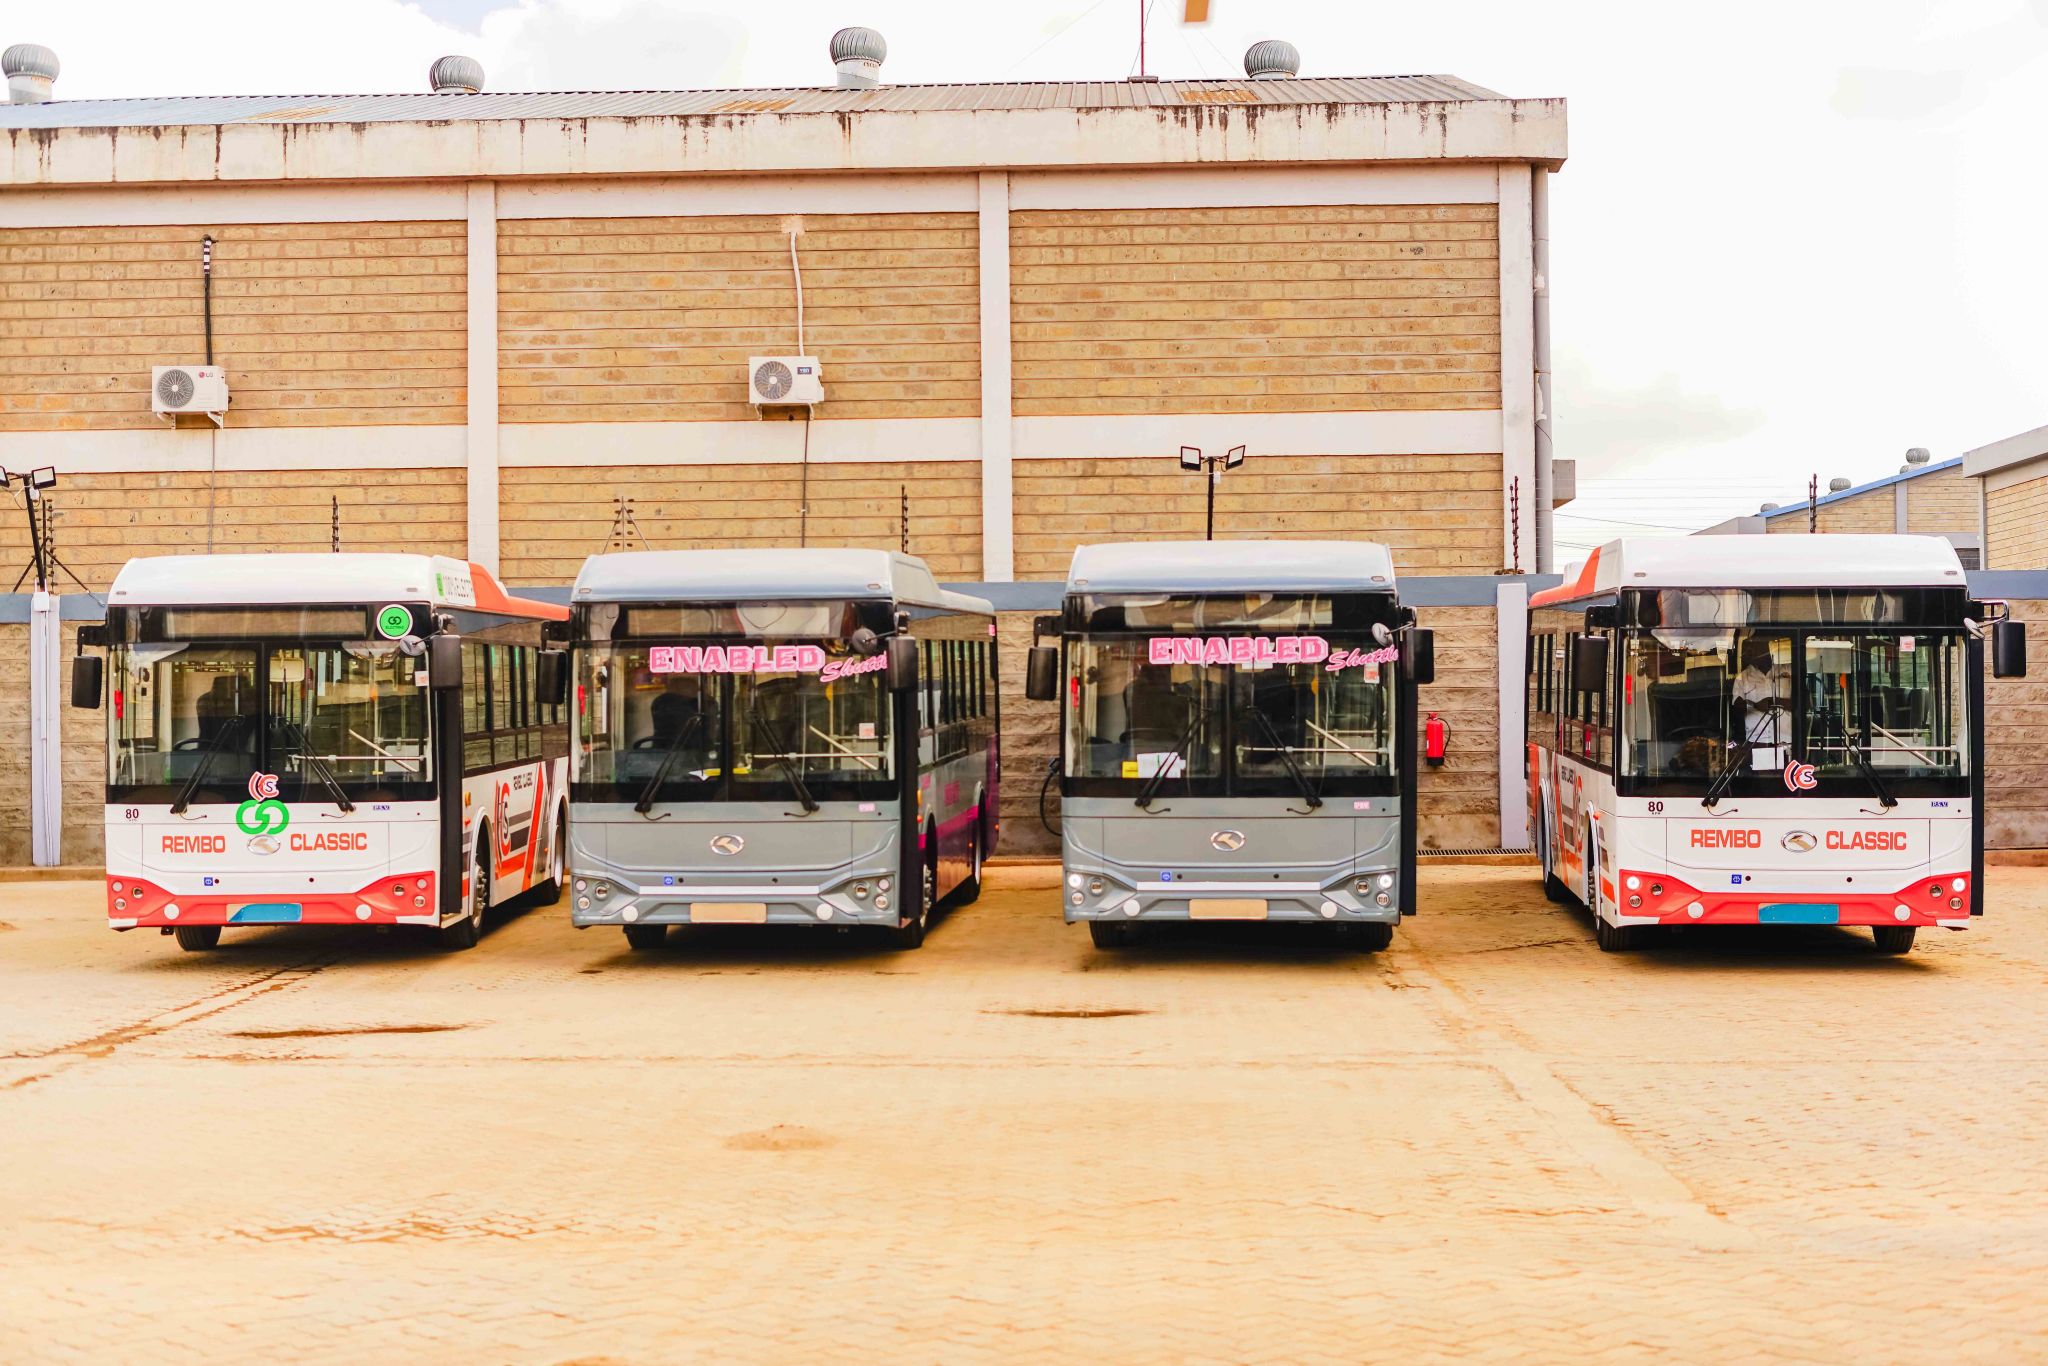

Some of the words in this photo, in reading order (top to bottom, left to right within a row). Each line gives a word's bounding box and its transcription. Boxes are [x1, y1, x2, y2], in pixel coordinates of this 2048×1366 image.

[649, 645, 825, 673] ENABLED
[1149, 636, 1328, 664] ENABLED
[125, 808, 139, 819] 80
[1648, 801, 1664, 812] 80
[162, 835, 226, 854] REMBO
[290, 832, 367, 851] CLASSIC
[1691, 829, 1761, 848] REMBO
[1826, 830, 1907, 851] CLASSIC
